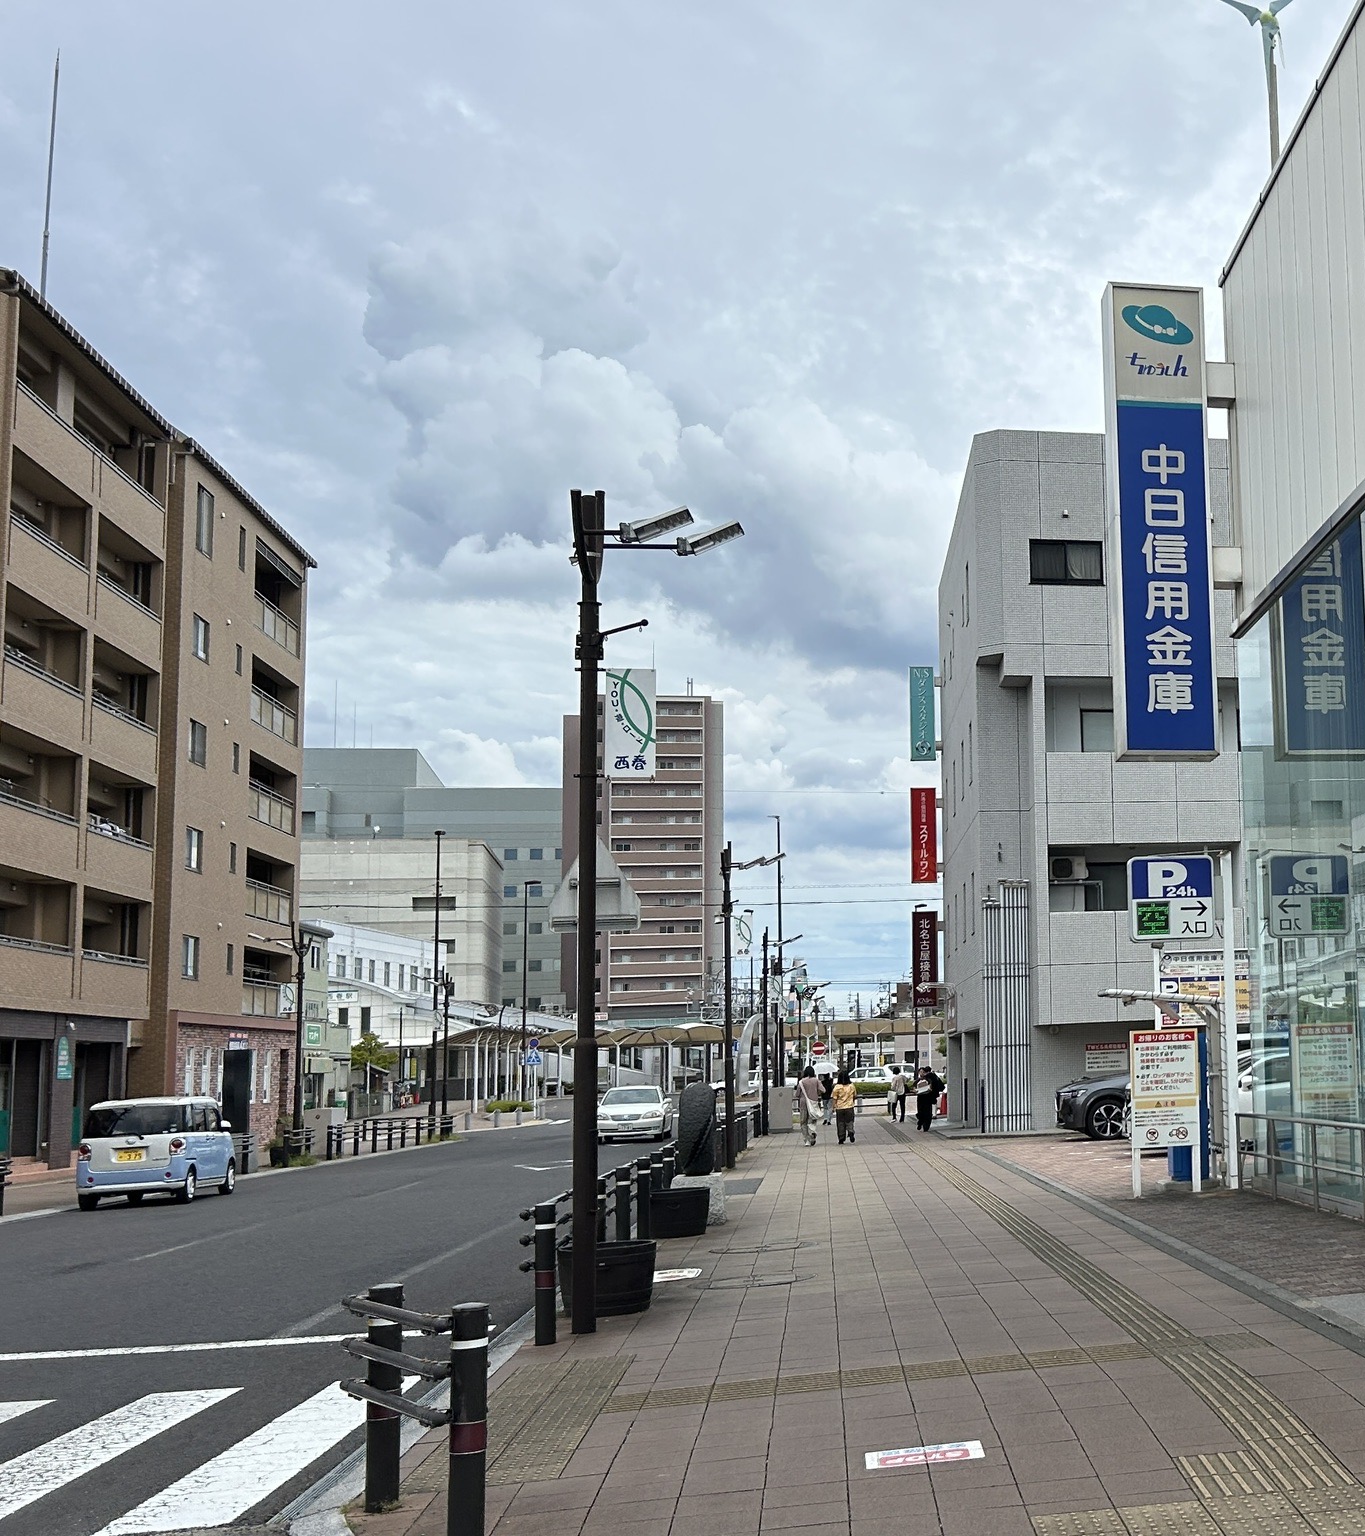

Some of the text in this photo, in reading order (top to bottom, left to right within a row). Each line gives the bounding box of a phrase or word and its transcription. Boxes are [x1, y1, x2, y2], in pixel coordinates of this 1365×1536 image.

[1125, 352, 1189, 377] ちゅうしん
[1142, 443, 1194, 714] 中日信用金庫
[614, 755, 647, 770] 西春
[1147, 861, 1188, 898] P
[1166, 885, 1198, 898] 24h
[1182, 921, 1207, 934] 入口
[919, 919, 931, 993] 北名古屋接骨
[1138, 1033, 1192, 1041] お帰りのお客様へ
